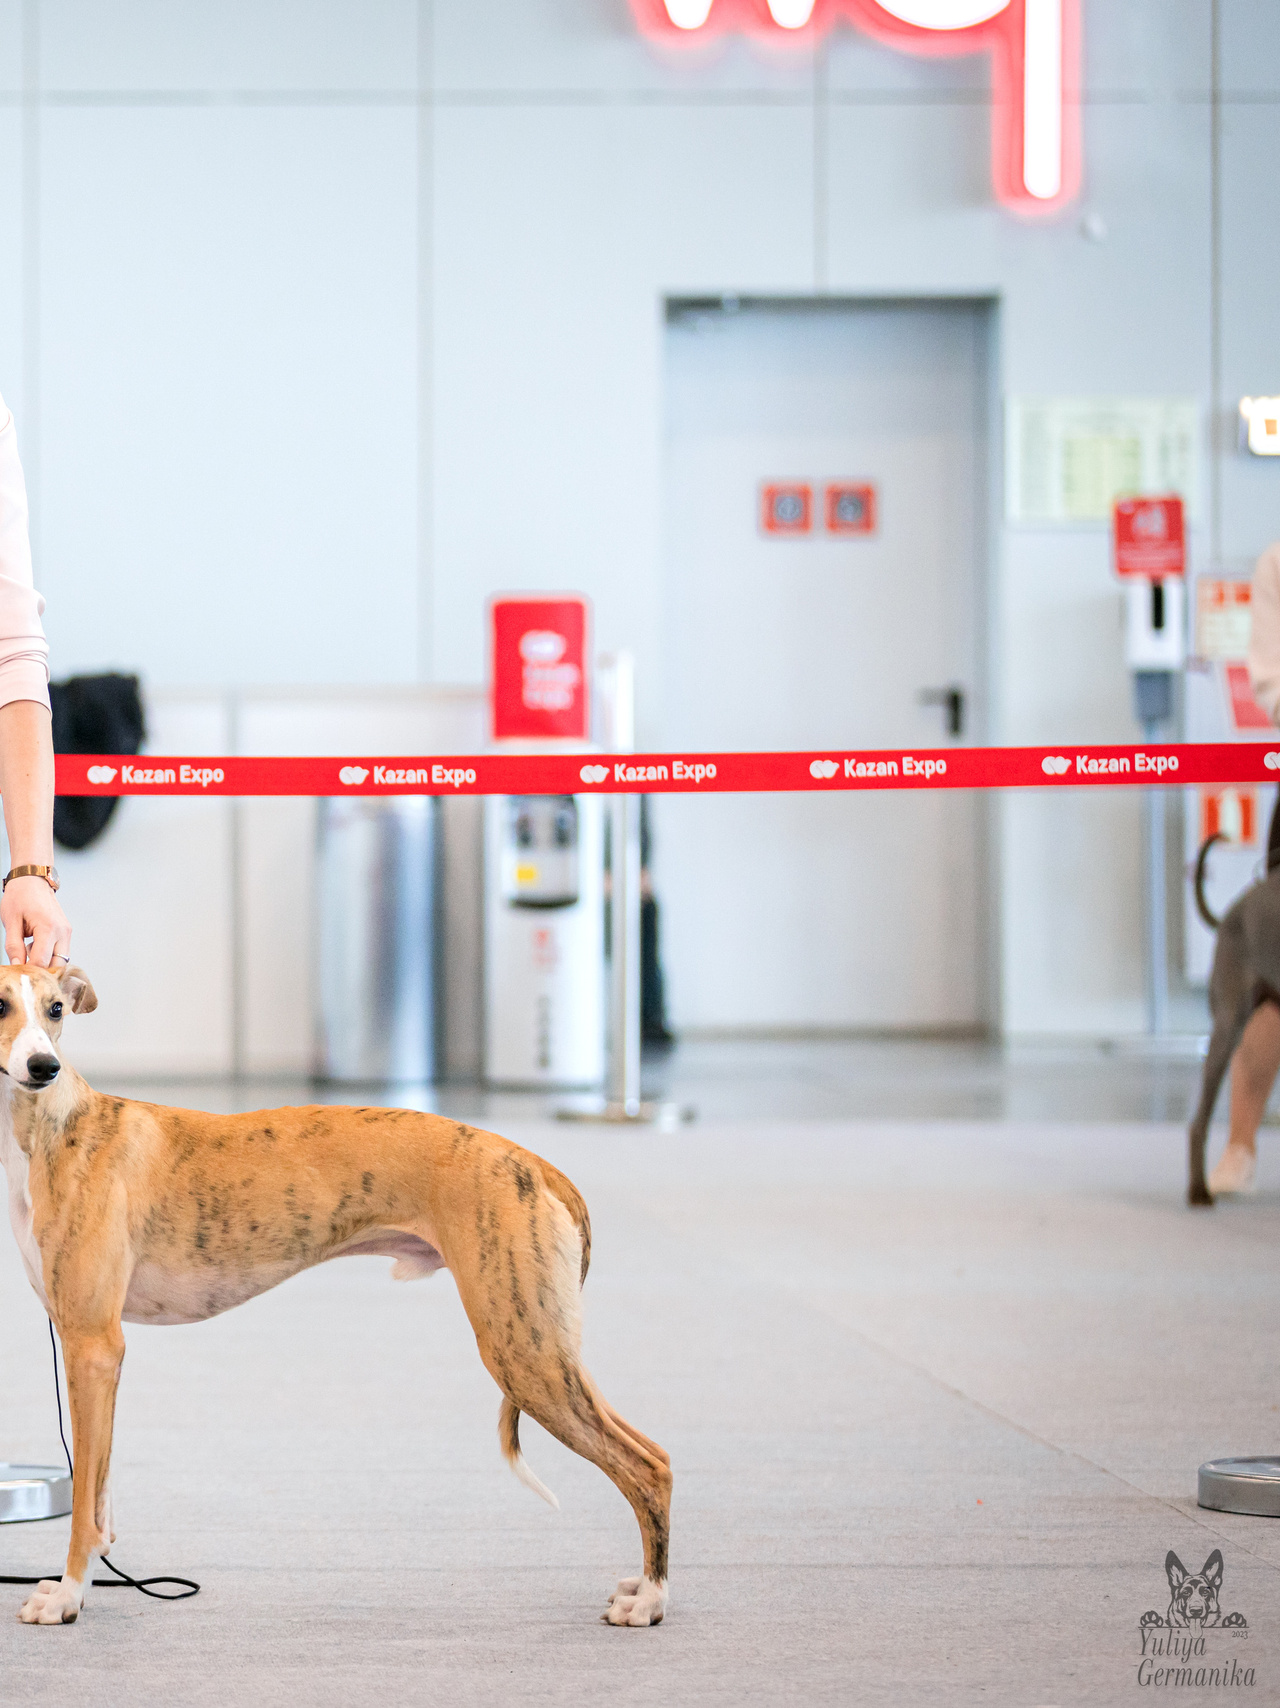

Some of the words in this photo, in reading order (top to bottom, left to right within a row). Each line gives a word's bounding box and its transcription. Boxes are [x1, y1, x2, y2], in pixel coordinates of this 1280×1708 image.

[614, 763, 668, 782] Kazan
[673, 761, 716, 783] Expo
[844, 759, 898, 778] Kazan
[902, 757, 946, 779] Expo
[1076, 755, 1130, 774] Kazan
[1135, 753, 1178, 775] Expo
[122, 765, 176, 784] Kazan
[180, 765, 224, 787] Expo
[374, 766, 428, 784] Kazan
[432, 765, 476, 788] Expo
